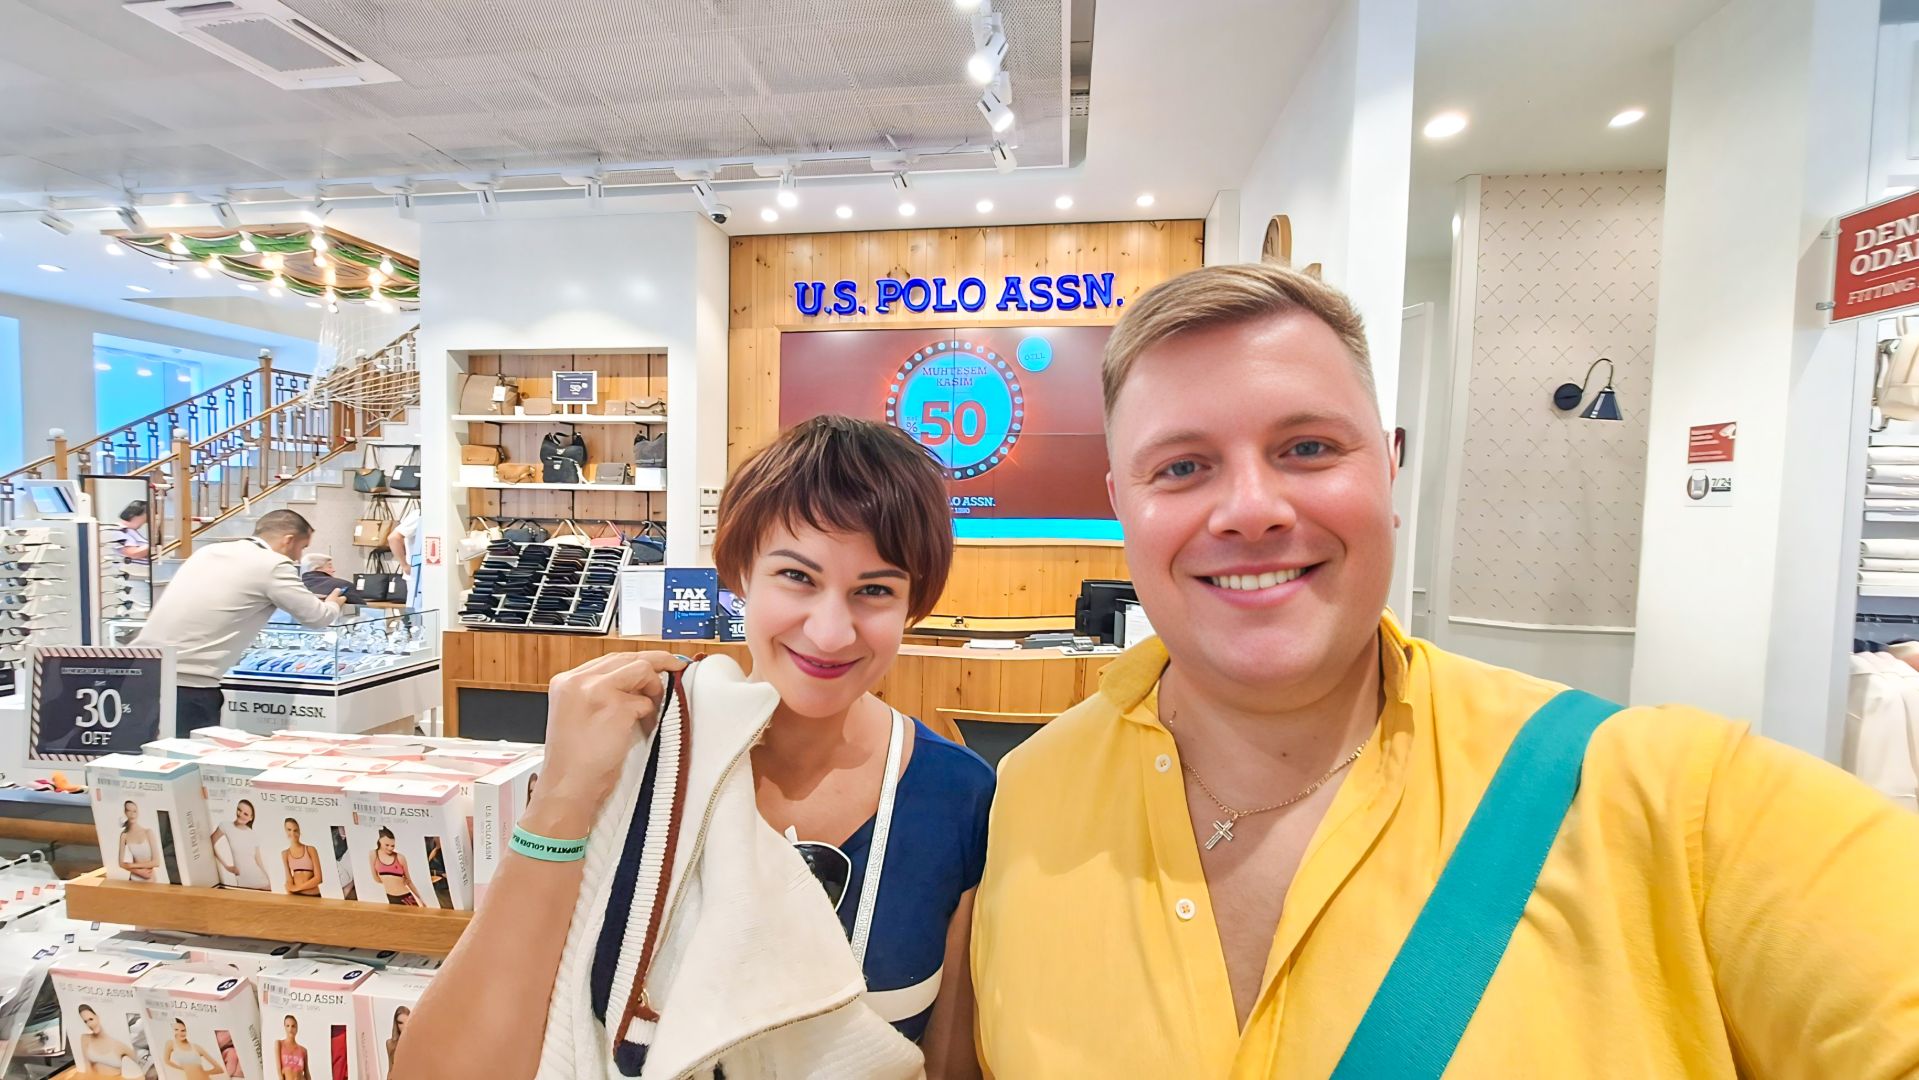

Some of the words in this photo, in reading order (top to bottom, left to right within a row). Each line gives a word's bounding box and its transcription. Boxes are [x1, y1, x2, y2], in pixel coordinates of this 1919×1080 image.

[794, 280, 867, 316] U.S.
[876, 277, 987, 314] POLO
[996, 272, 1123, 312] ASSN.
[1846, 277, 1917, 305] FITTING
[936, 377, 973, 387] KASIM
[1711, 477, 1732, 487] 7/24
[962, 496, 996, 507] ASSN.
[672, 588, 707, 600] TAX
[668, 599, 711, 612] FREE
[228, 701, 250, 713] U.S.
[253, 702, 286, 715] POLO
[289, 705, 327, 719] ASSN.
[81, 731, 112, 745] OFF
[280, 793, 308, 805] POLO
[289, 990, 312, 1003] OLO
